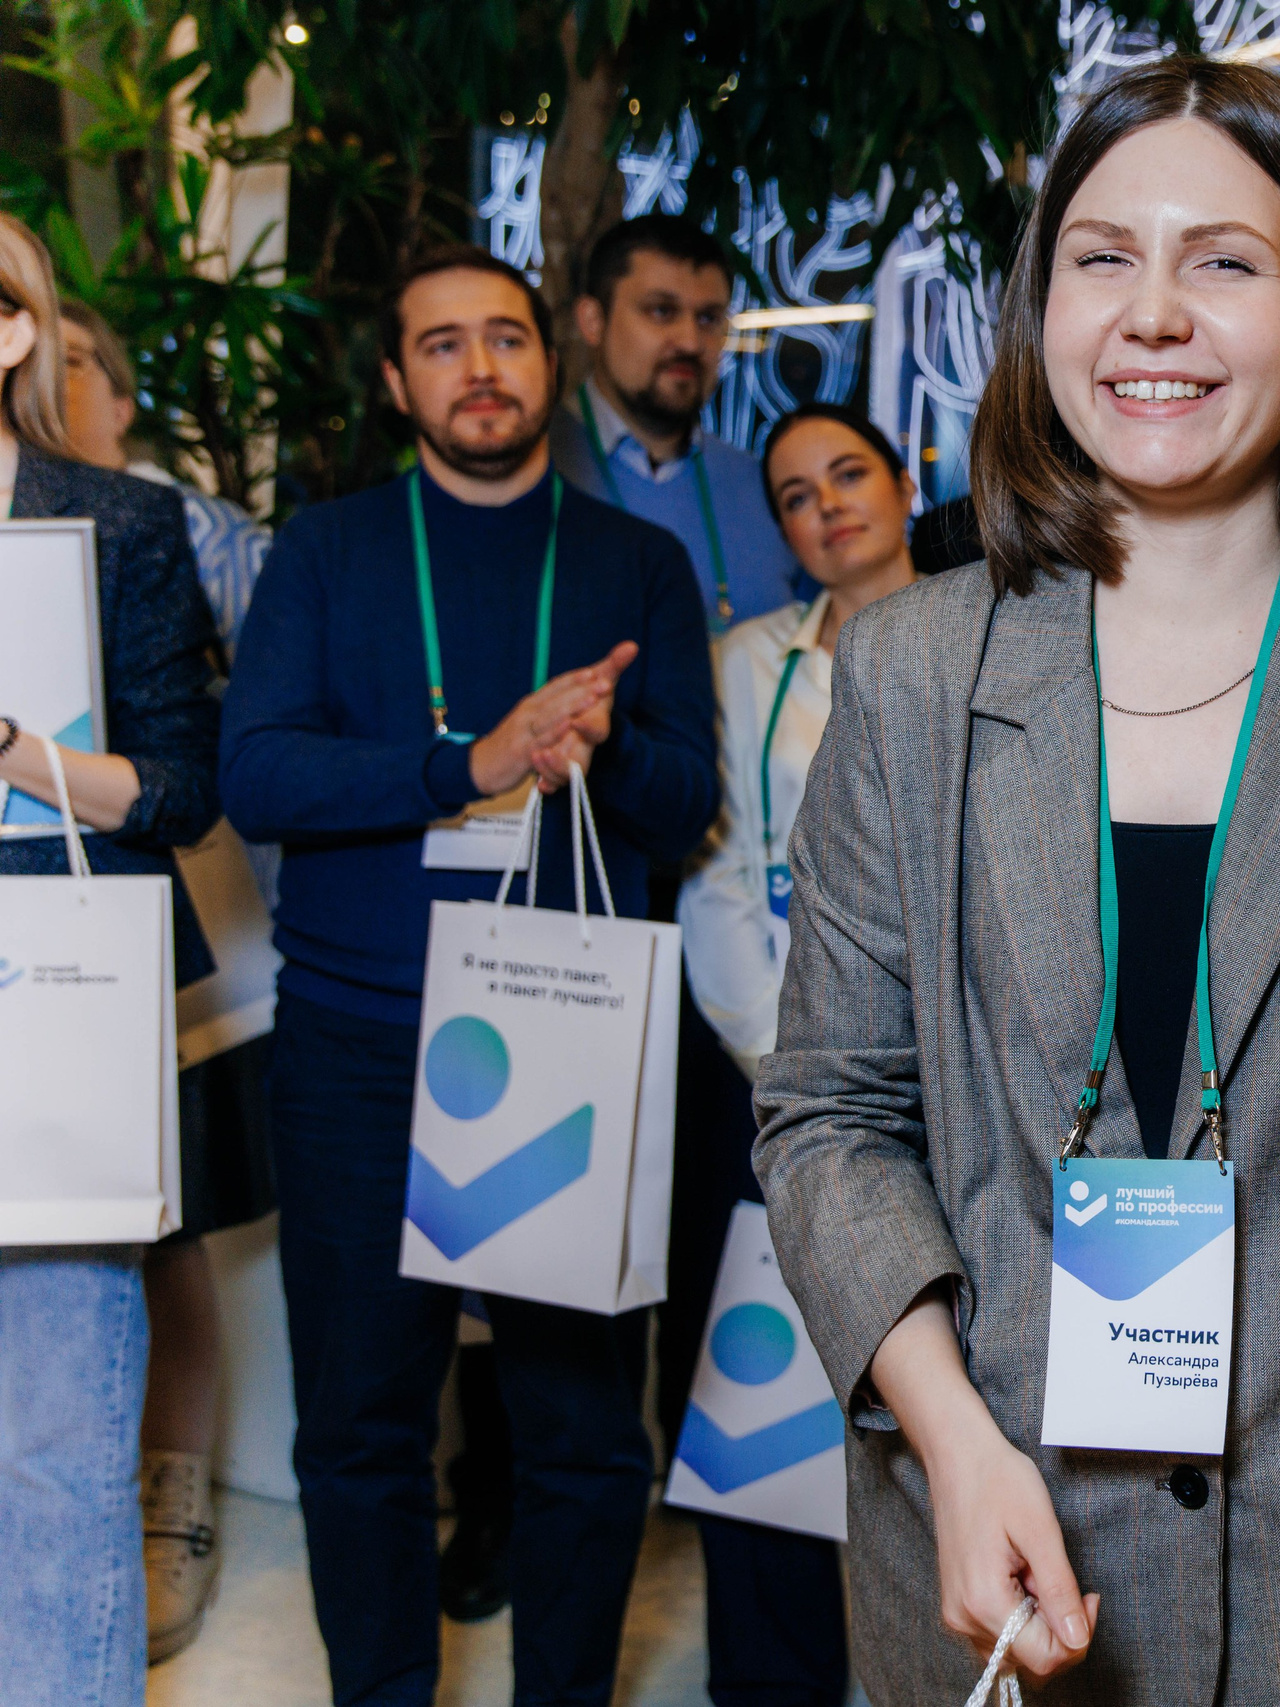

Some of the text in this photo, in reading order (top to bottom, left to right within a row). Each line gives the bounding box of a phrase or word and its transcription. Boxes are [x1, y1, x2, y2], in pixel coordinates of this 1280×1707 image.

[462, 952, 612, 990] Я не просто пакет,
[503, 981, 549, 998] пакет
[1115, 1185, 1175, 1201] лучший
[1115, 1199, 1224, 1216] по профессии
[1115, 1218, 1180, 1227] #КОМАНДАСБЕРА
[1108, 1322, 1220, 1346] Участник
[1128, 1351, 1220, 1370] Александра
[1143, 1372, 1219, 1390] Пузырёва
